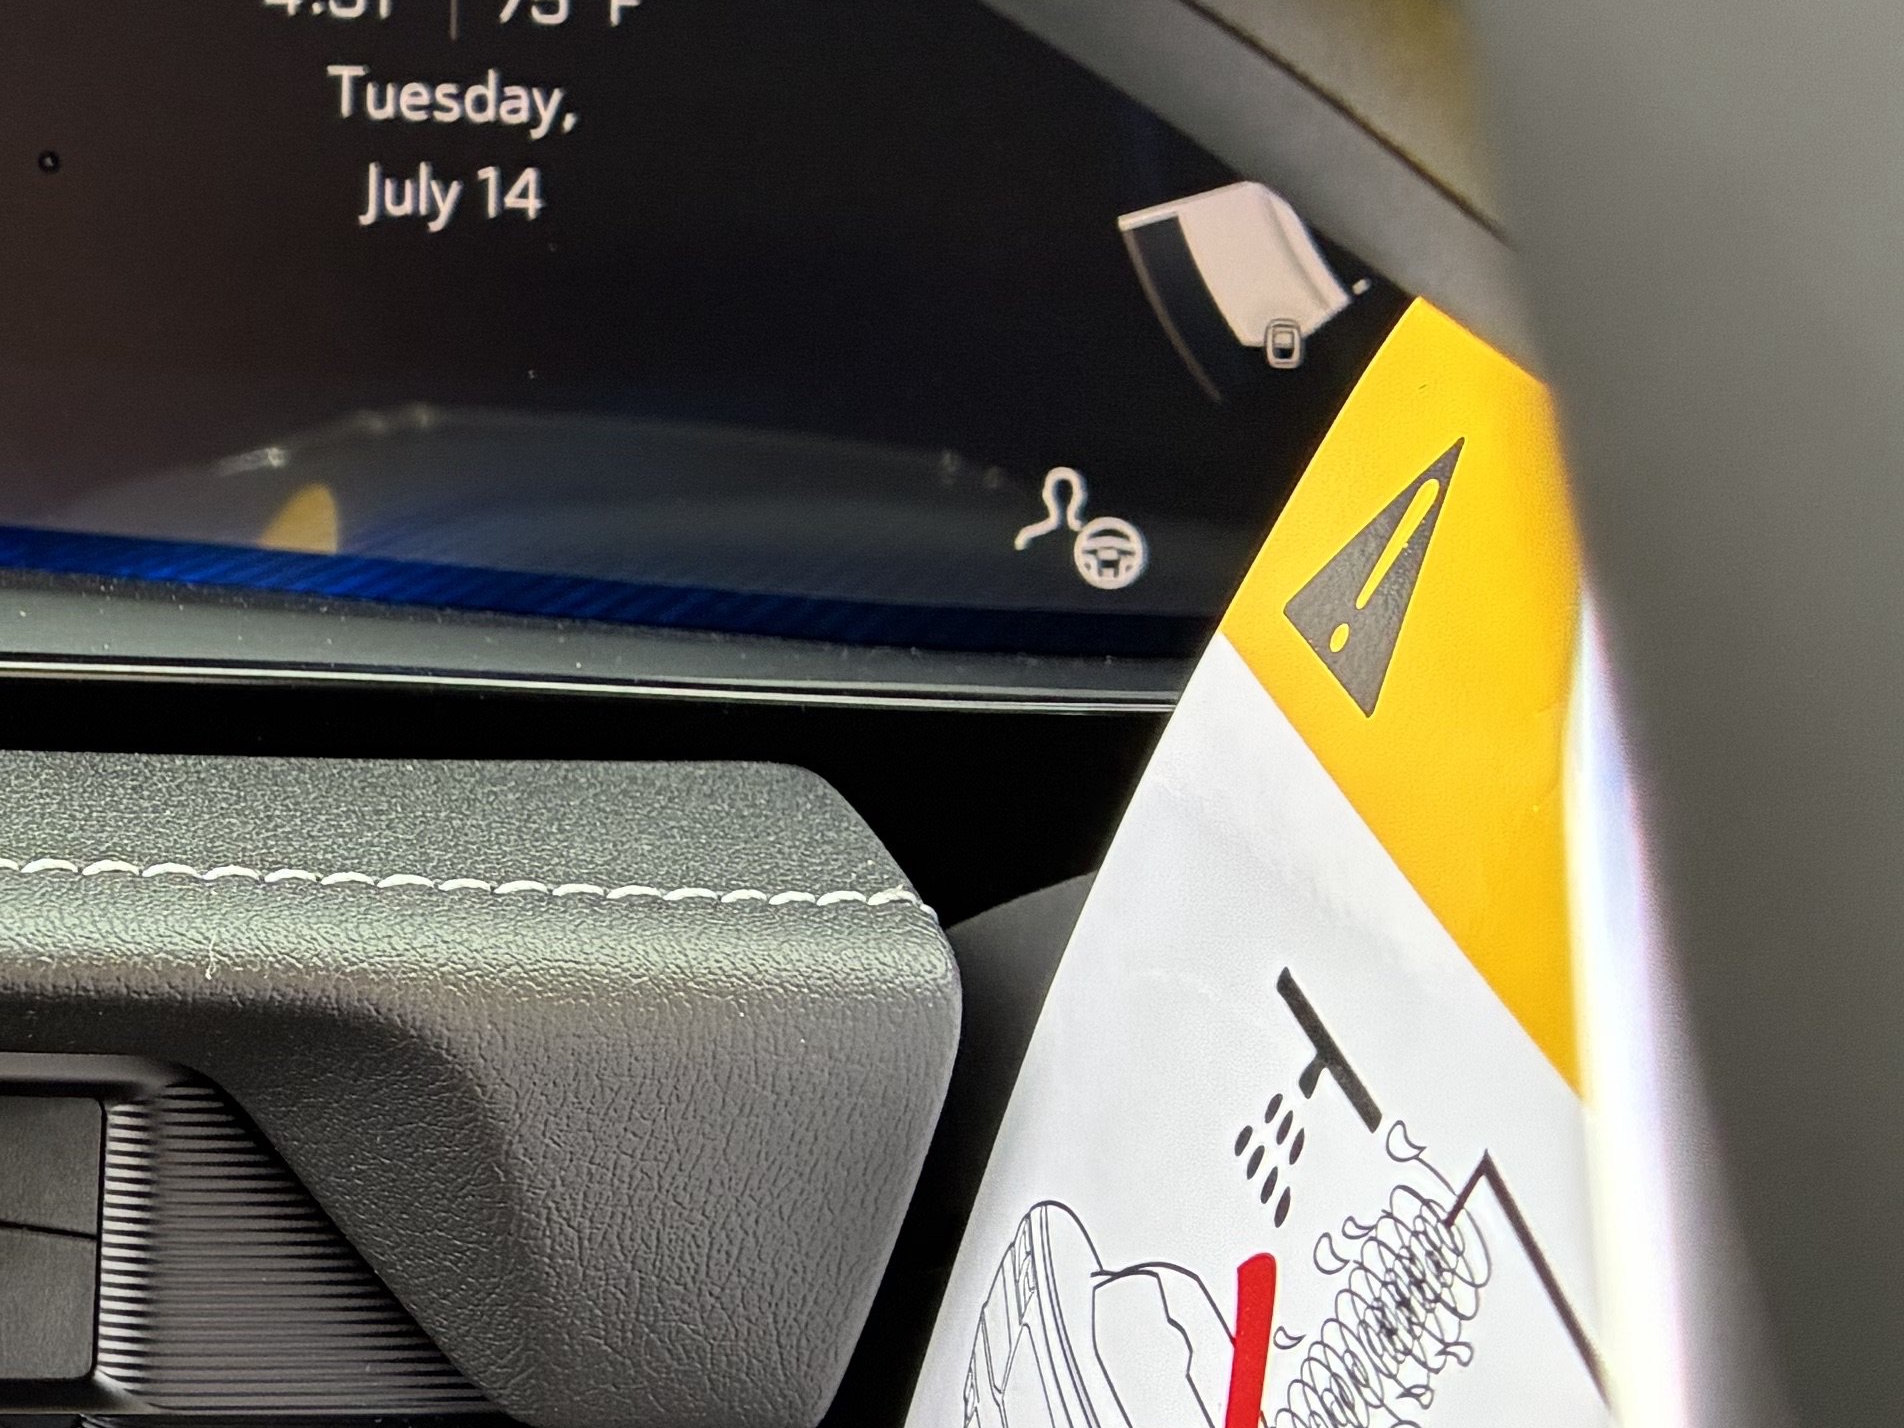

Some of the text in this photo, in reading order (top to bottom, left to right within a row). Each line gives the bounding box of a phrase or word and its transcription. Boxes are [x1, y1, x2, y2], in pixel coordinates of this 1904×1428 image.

[325, 64, 578, 138] Tuesday,
[357, 160, 544, 232] July 14
